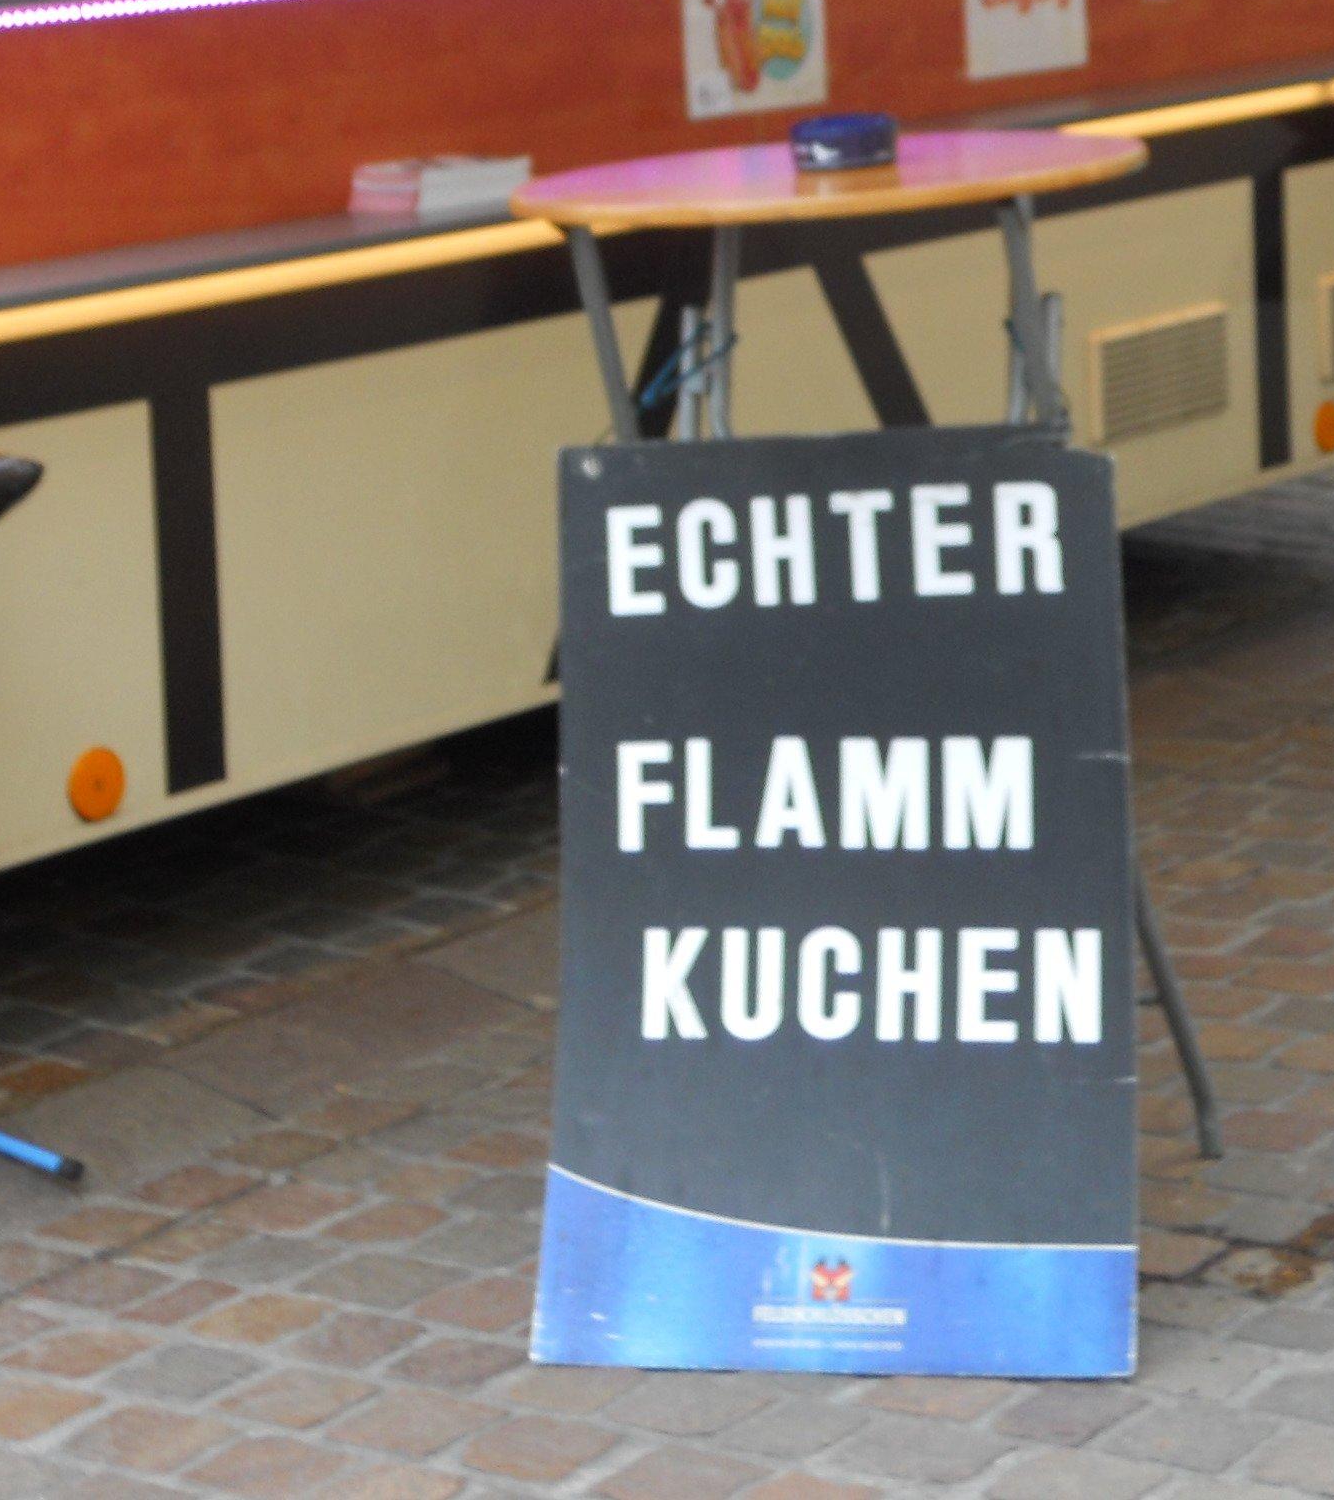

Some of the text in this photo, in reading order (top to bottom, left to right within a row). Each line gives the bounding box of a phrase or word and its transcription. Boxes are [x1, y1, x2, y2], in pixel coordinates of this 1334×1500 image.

[605, 479, 1066, 618] ECHTER
[615, 735, 1035, 854] FLAMM
[640, 926, 1104, 1046] KUCHEN
